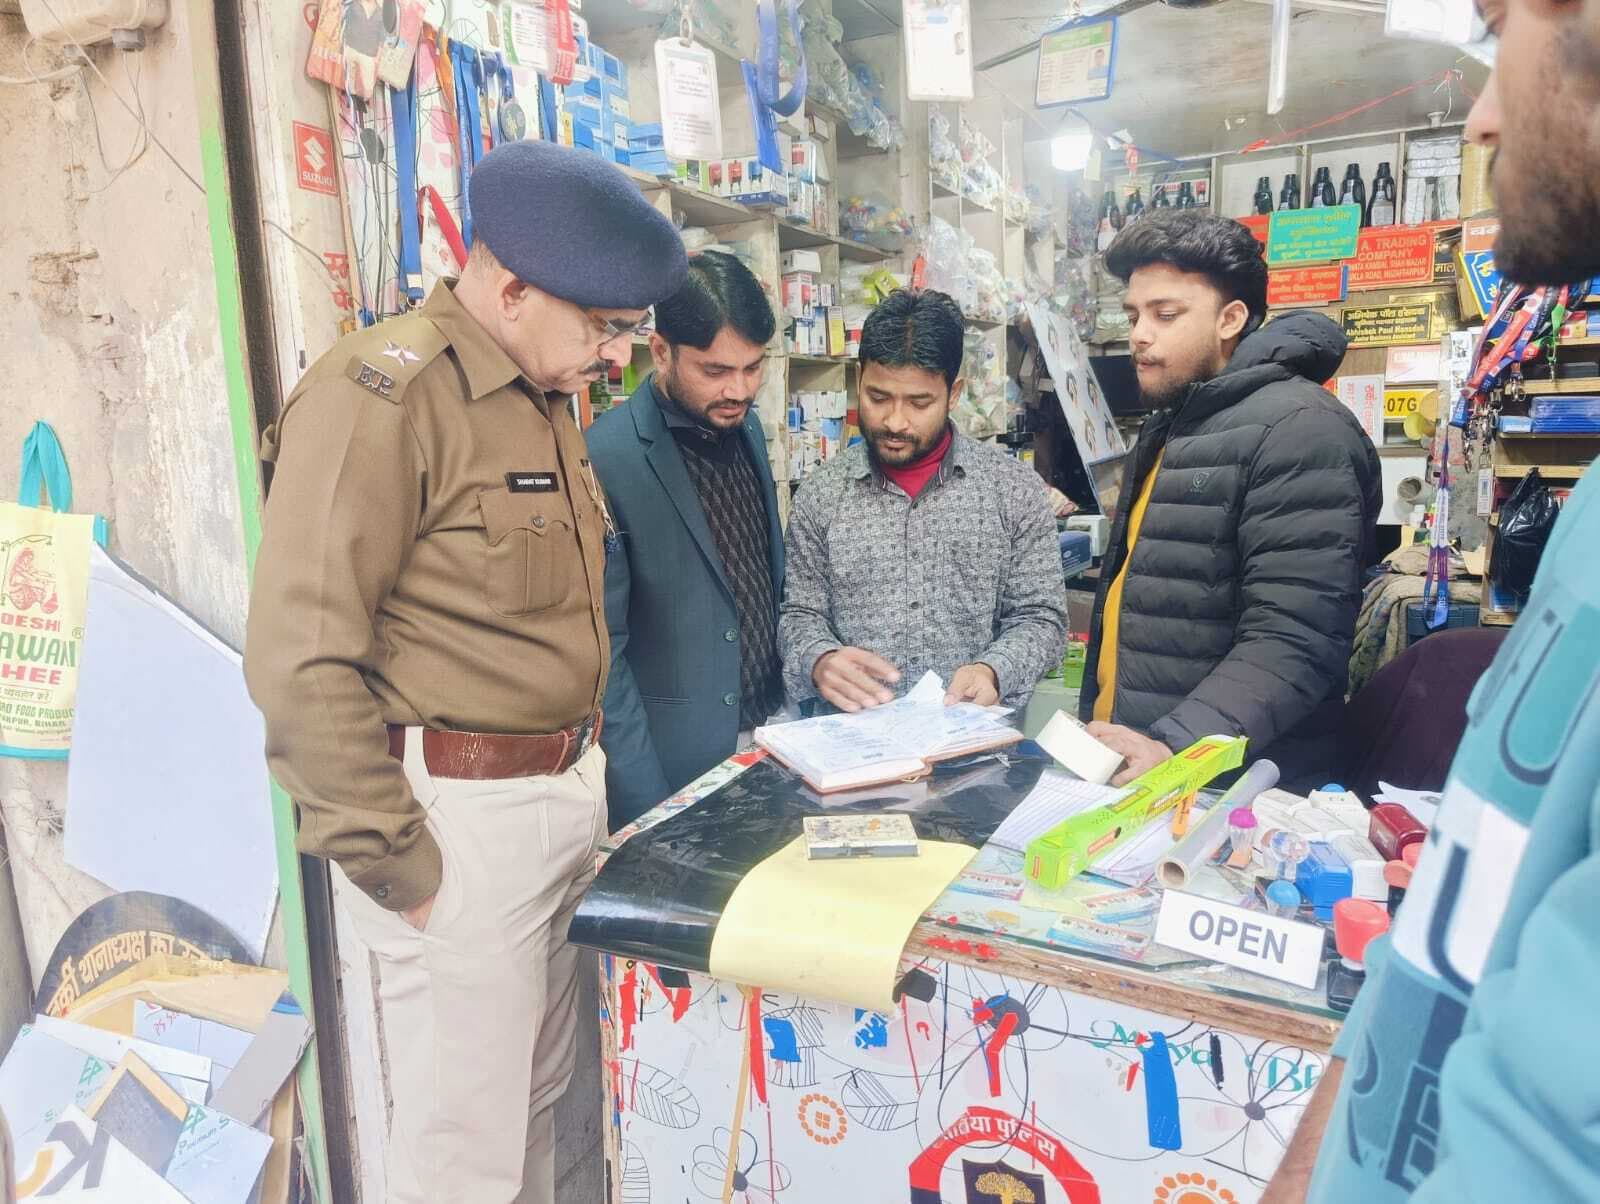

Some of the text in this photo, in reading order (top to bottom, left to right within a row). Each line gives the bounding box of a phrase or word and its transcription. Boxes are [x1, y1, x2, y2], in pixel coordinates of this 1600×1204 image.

[1376, 234, 1427, 249] TRADING
[1358, 248, 1413, 262] COMPANY
[1189, 909, 1289, 964] OPEN
